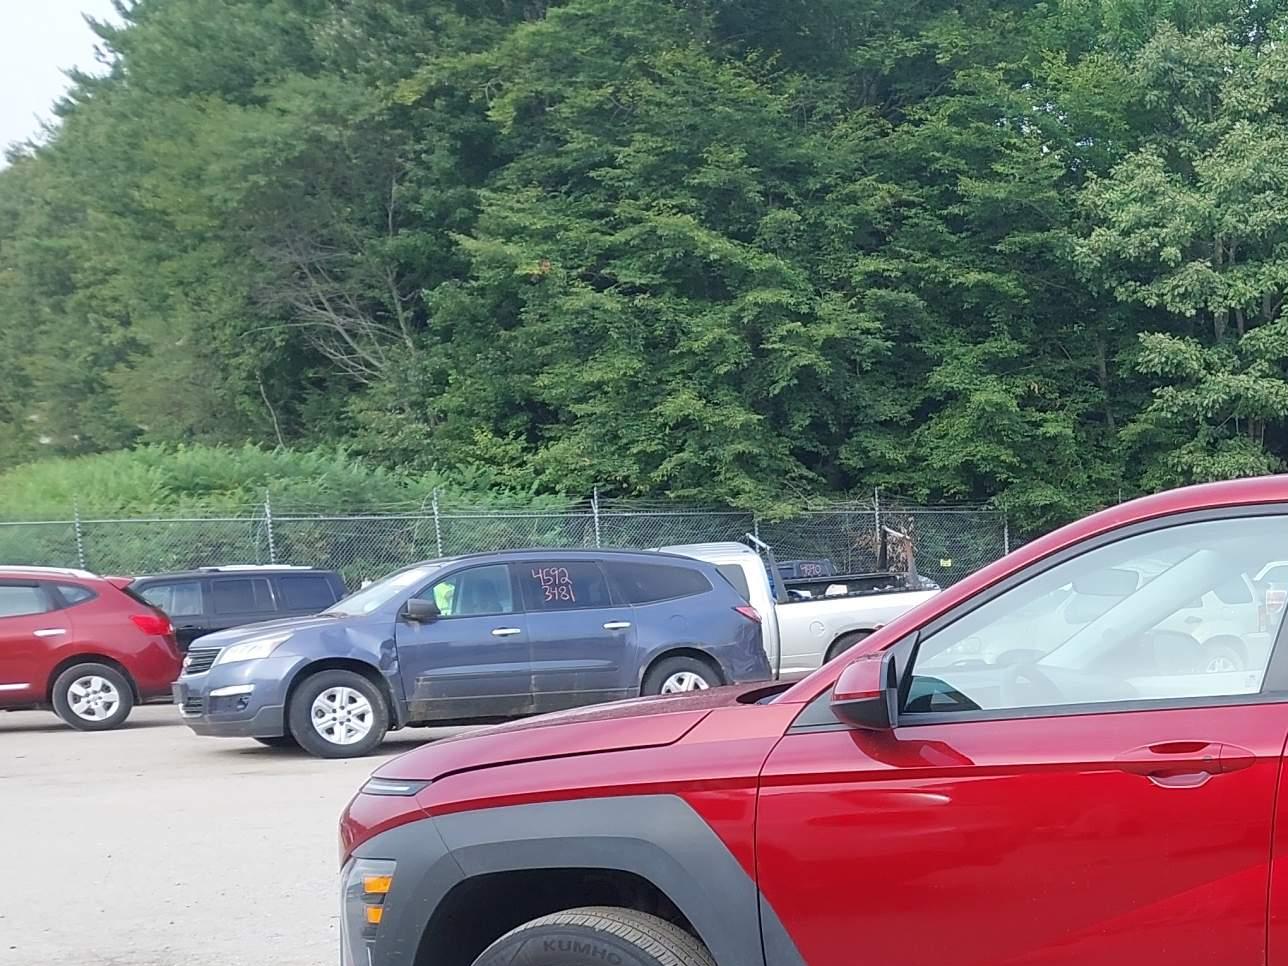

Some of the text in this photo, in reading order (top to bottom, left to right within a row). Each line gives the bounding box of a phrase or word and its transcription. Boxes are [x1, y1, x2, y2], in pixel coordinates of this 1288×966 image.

[531, 567, 573, 586] 4592
[541, 584, 576, 602] 3481
[543, 940, 622, 965] KUMHO
